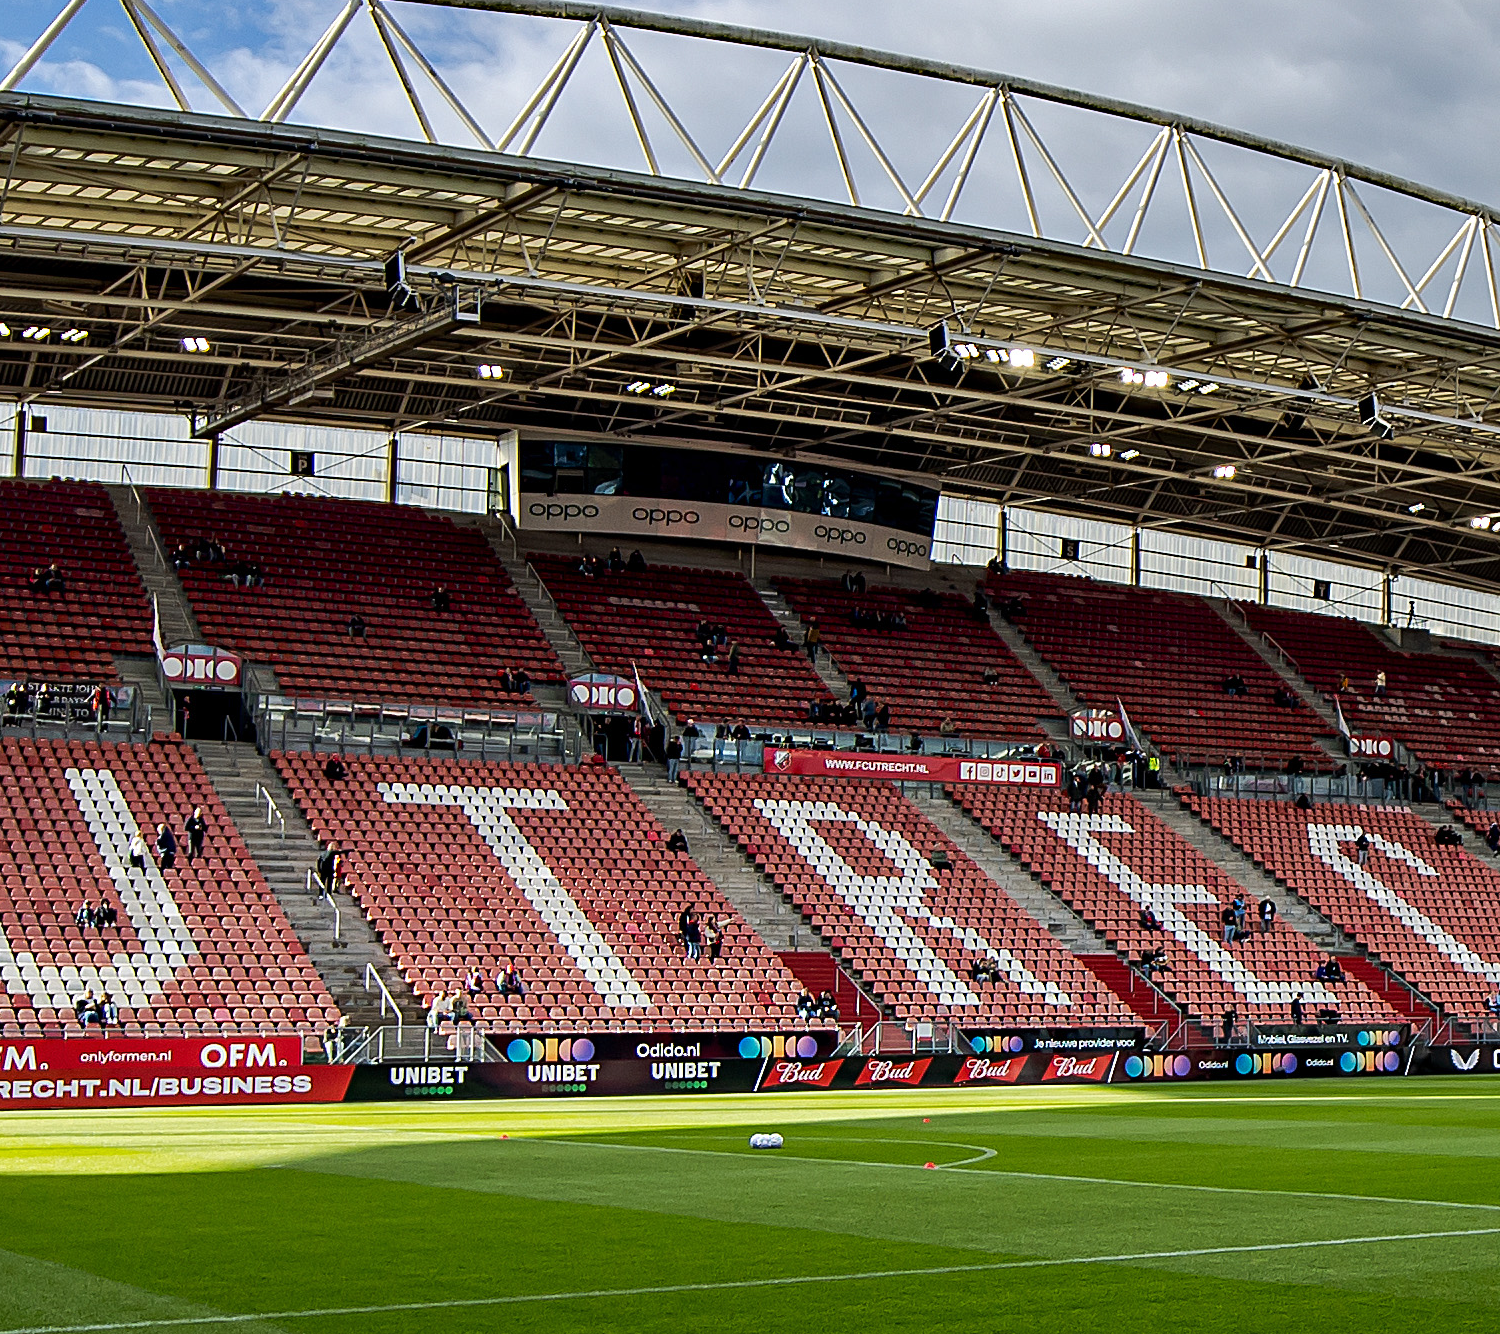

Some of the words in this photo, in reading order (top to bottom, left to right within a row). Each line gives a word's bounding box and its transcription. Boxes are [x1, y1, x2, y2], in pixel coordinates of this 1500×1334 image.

[298, 460, 307, 472] P
[529, 502, 599, 520] oppo
[633, 506, 700, 525] oppo
[728, 513, 790, 534] oppo
[814, 525, 866, 544] oppo
[886, 537, 926, 558] oppo
[825, 758, 929, 774] WWW.FCUTRECHT.NL
[637, 1042, 701, 1059] Odido.nl
[1034, 1040, 1043, 1048] Je
[1045, 1039, 1077, 1048] nieuwe
[1079, 1038, 1113, 1050] provider
[1115, 1038, 1136, 1048] voor
[80, 1048, 172, 1065] onlyformen.nl
[200, 1043, 288, 1068] OFM.
[390, 1066, 467, 1085] UNIBET
[528, 1064, 600, 1082] UNIBET
[651, 1062, 721, 1080] UNIBET
[776, 1062, 824, 1082] Bud
[868, 1059, 915, 1080] Bud
[966, 1058, 1010, 1079] Bud
[1054, 1057, 1097, 1078] Bud
